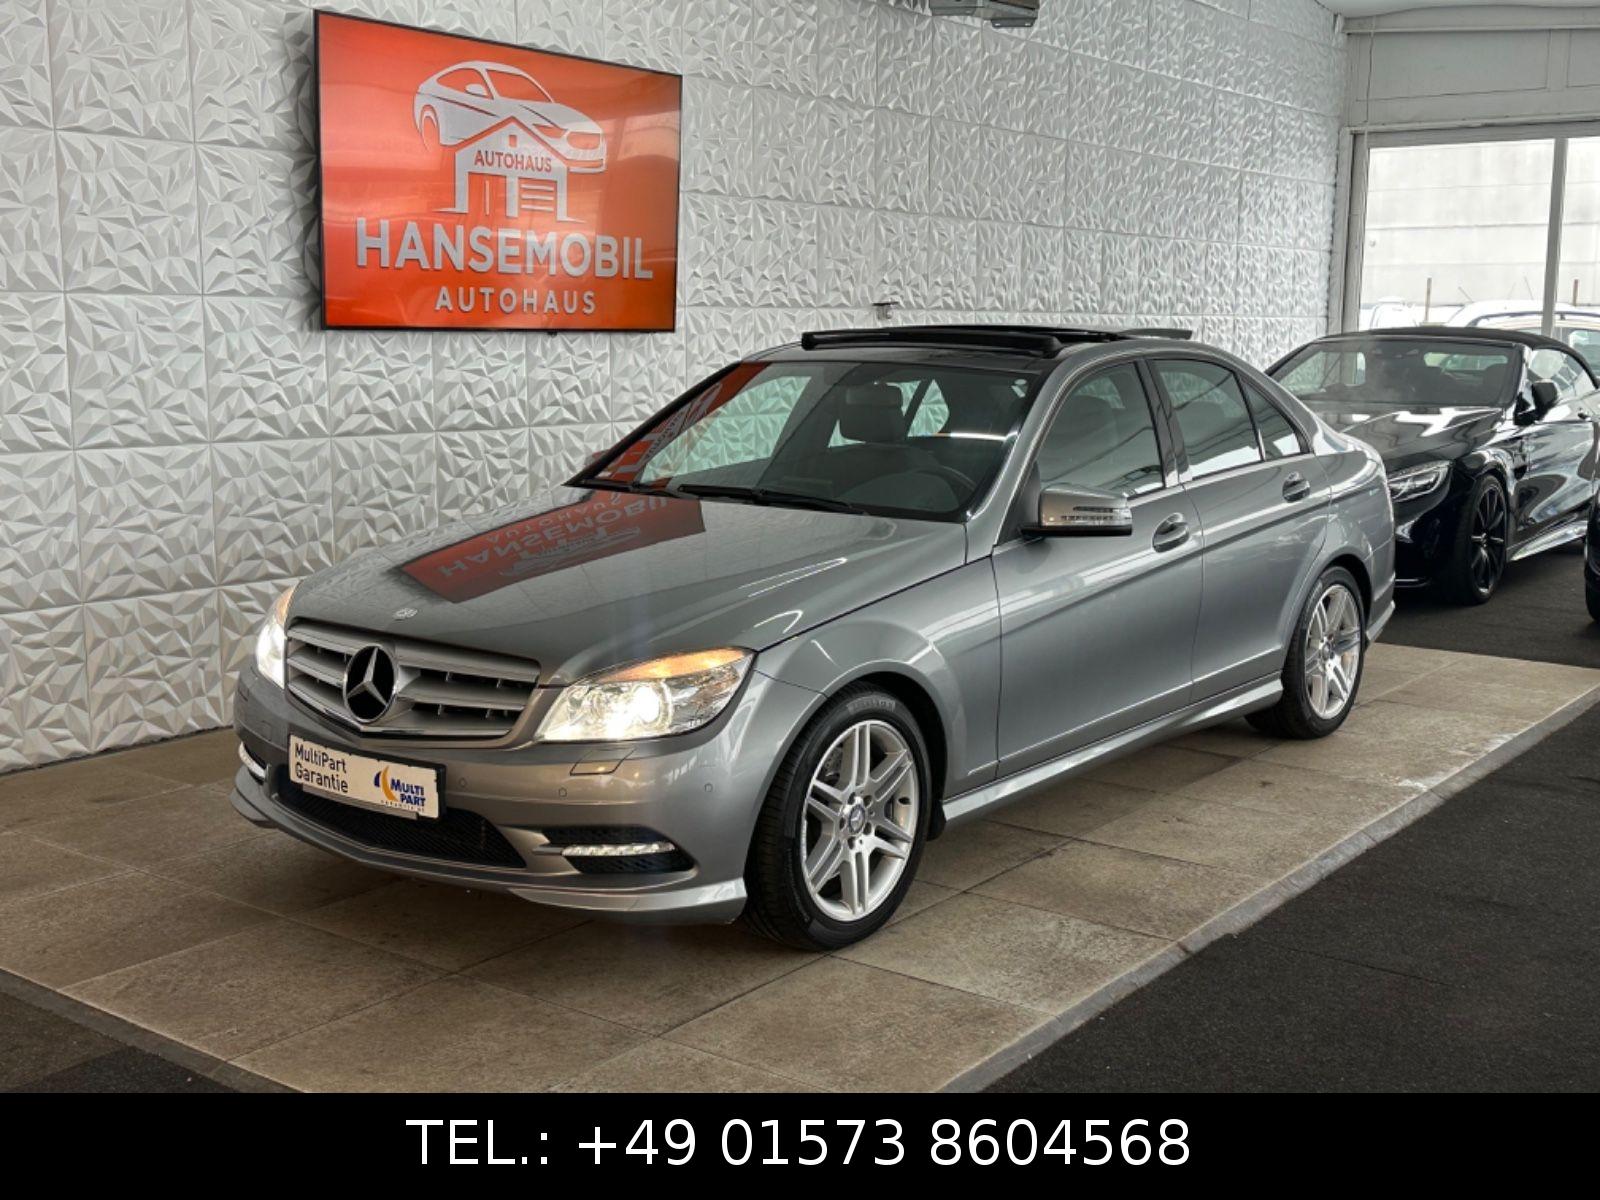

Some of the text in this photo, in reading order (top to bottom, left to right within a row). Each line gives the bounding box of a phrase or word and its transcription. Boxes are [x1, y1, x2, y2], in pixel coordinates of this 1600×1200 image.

[474, 150, 552, 172] AUTOHAUS
[355, 217, 653, 279] HANSEMOBIL
[435, 286, 596, 314] AUTOHAUS
[295, 744, 347, 774] MultiPart
[295, 762, 349, 793] Garantie
[391, 779, 425, 795] MULTI
[399, 793, 426, 806] PART
